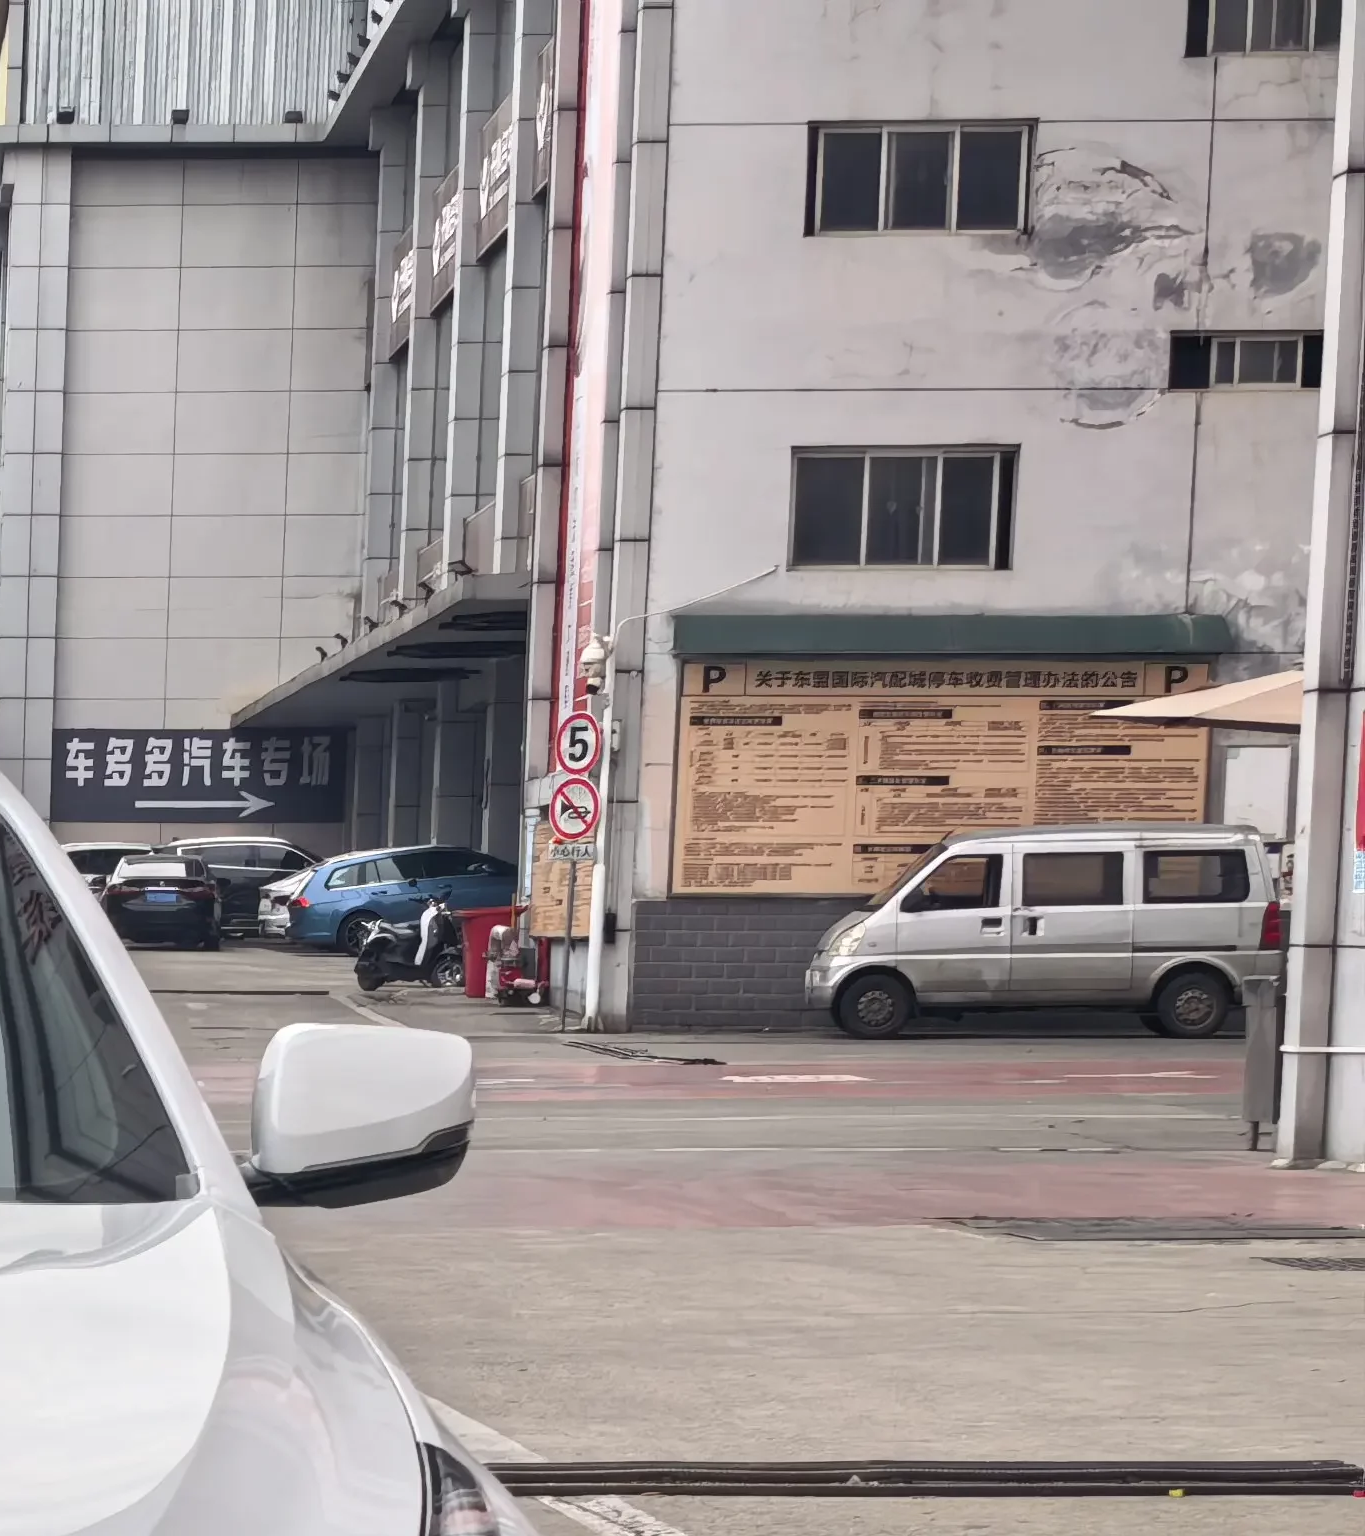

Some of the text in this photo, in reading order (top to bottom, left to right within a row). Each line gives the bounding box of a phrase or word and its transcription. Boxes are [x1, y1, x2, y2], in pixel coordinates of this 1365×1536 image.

[702, 665, 727, 693] P
[1164, 665, 1189, 694] P
[568, 726, 589, 762] 5
[65, 736, 332, 787] 车多多汽车专场
